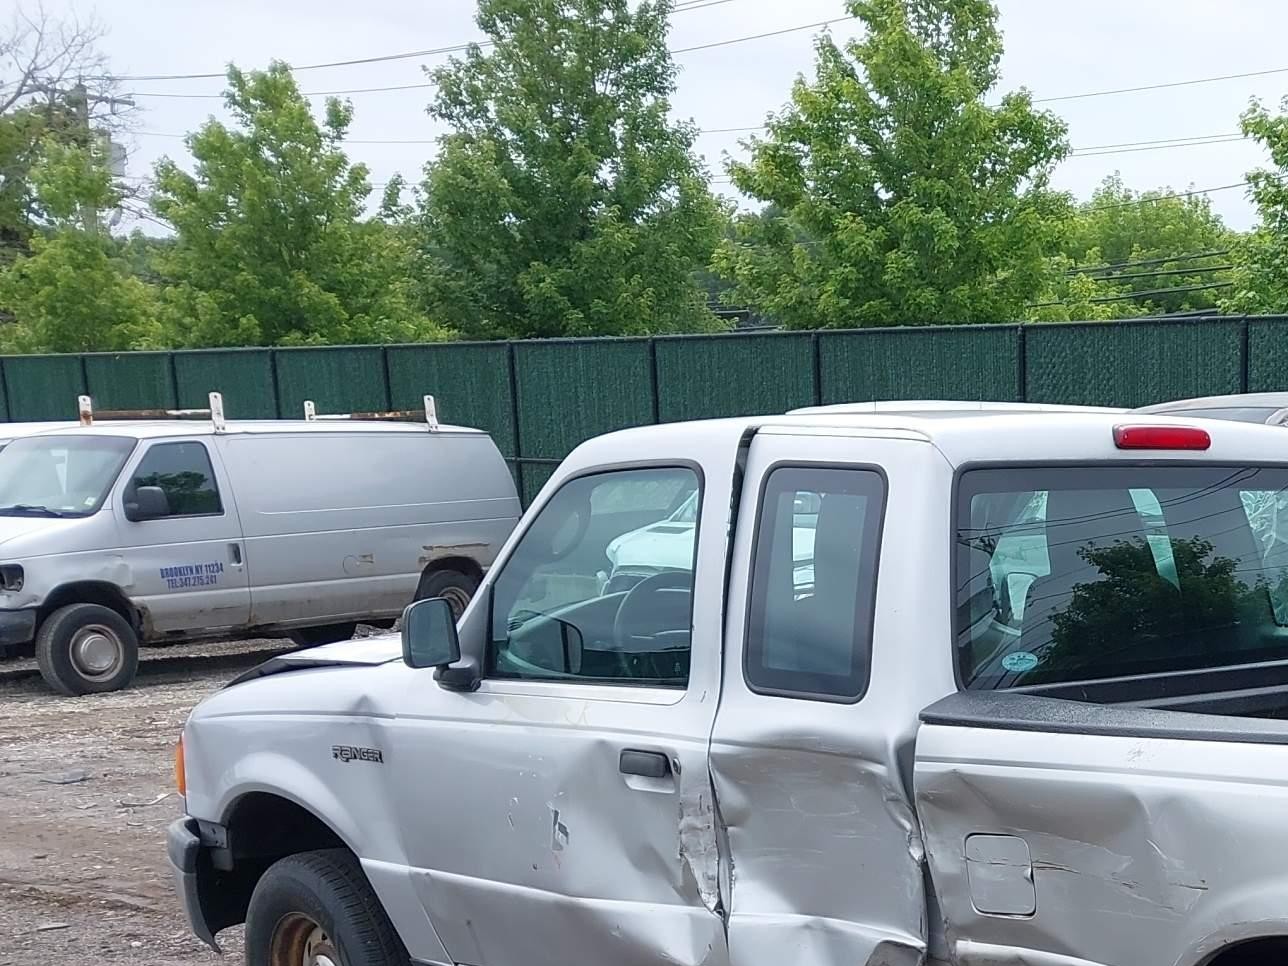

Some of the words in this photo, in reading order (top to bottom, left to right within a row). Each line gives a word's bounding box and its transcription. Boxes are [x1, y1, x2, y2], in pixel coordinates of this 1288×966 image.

[160, 566, 194, 579] BROOKLYN
[195, 563, 203, 576] NY
[204, 562, 224, 575] 11234
[332, 745, 384, 764] RANGER
